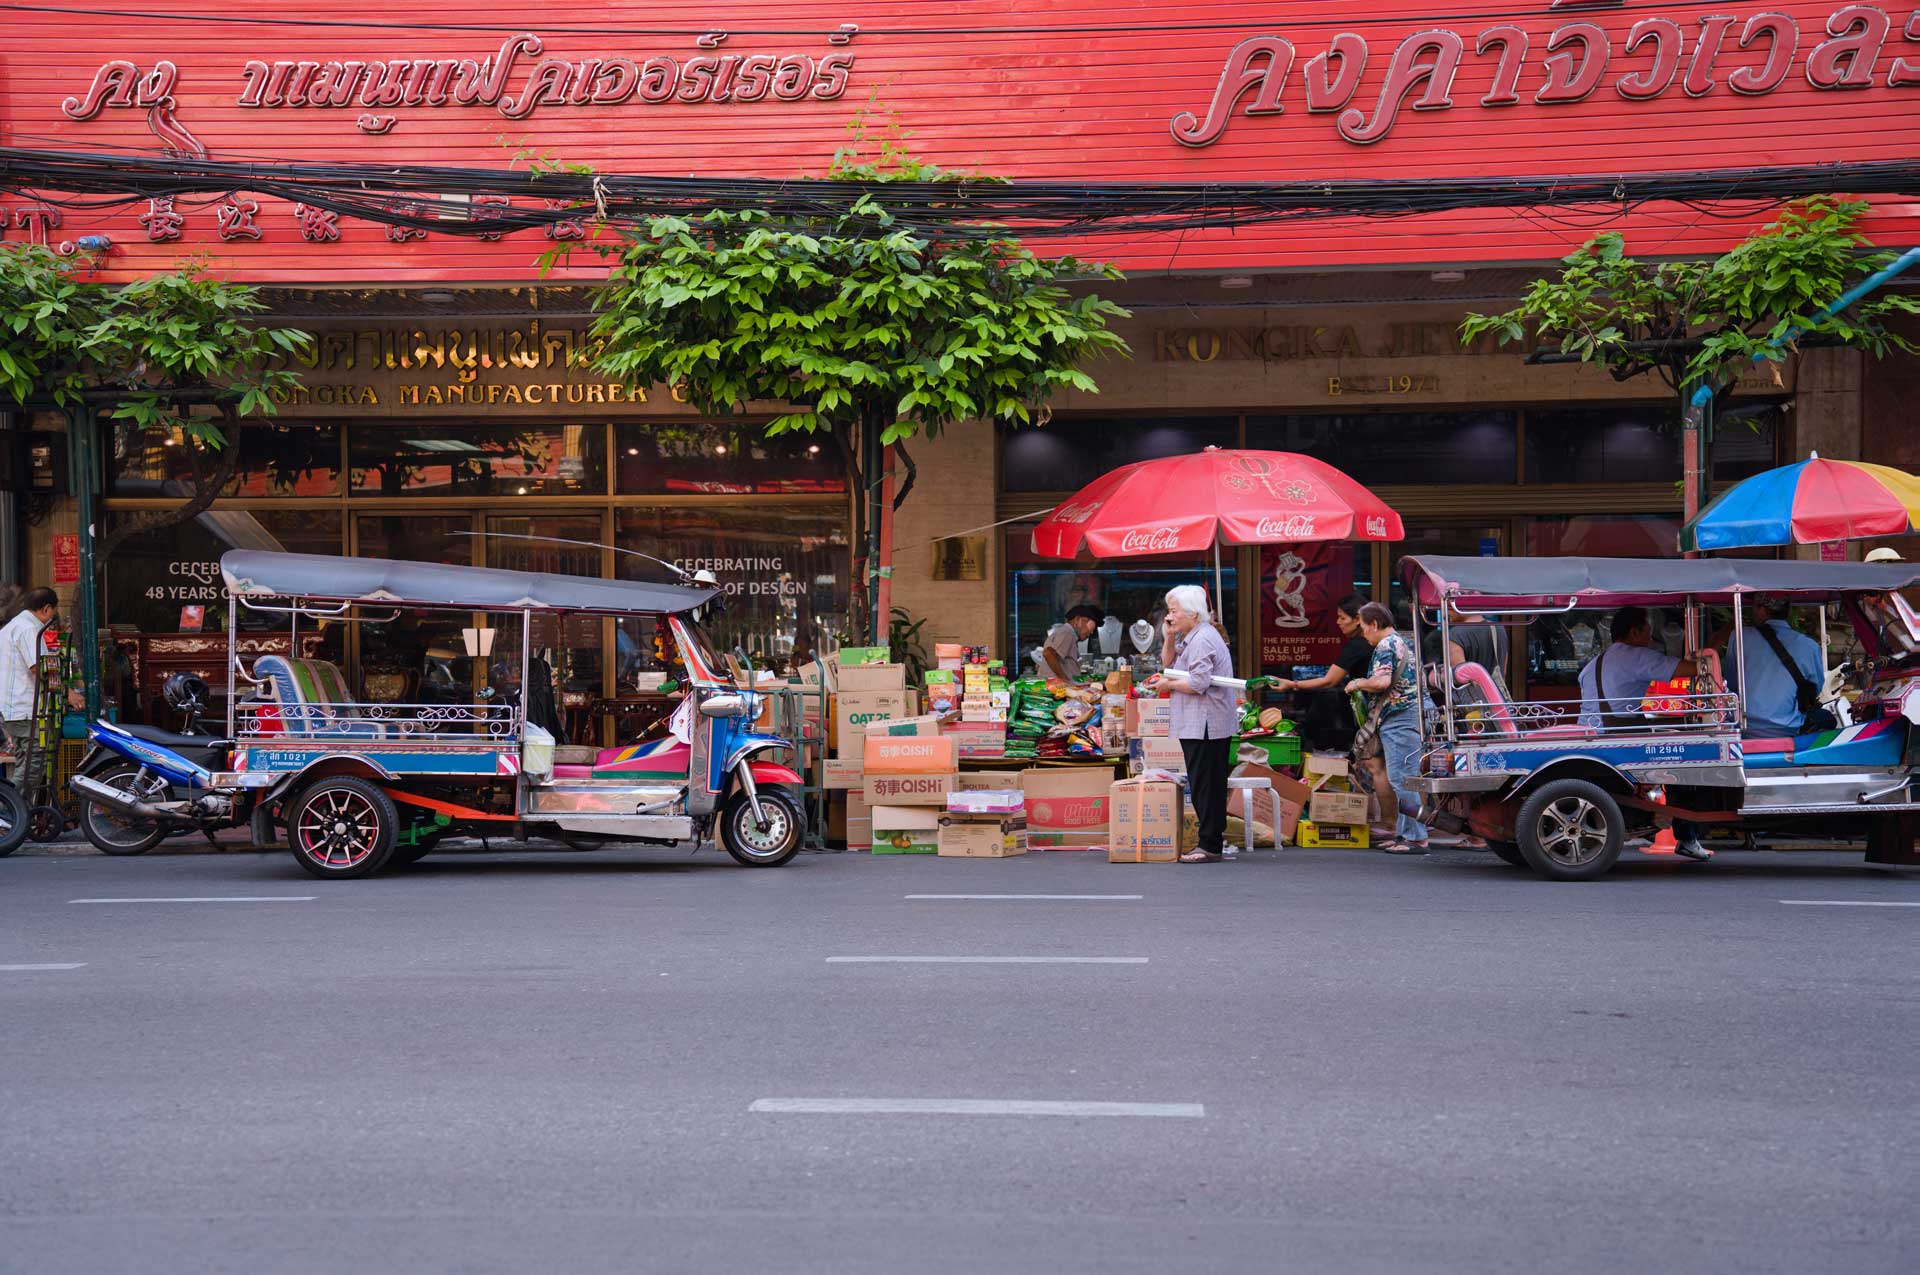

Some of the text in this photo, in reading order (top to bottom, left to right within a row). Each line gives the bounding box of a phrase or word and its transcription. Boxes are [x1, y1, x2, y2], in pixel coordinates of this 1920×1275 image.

[1154, 325, 1363, 362] KONGKA
[400, 383, 648, 404] MANUFACTURER
[1256, 515, 1317, 538] Coca-Cola
[1121, 527, 1182, 552] Coca-Cola
[674, 557, 782, 572] CELEBRATING
[145, 586, 164, 600] 48
[169, 586, 217, 600] YEARS
[724, 581, 807, 595] OF DESIGN
[1263, 646, 1307, 654] SALE UP
[849, 712, 875, 724] OAT
[283, 752, 306, 761] 1021
[1659, 745, 1685, 754] 2946
